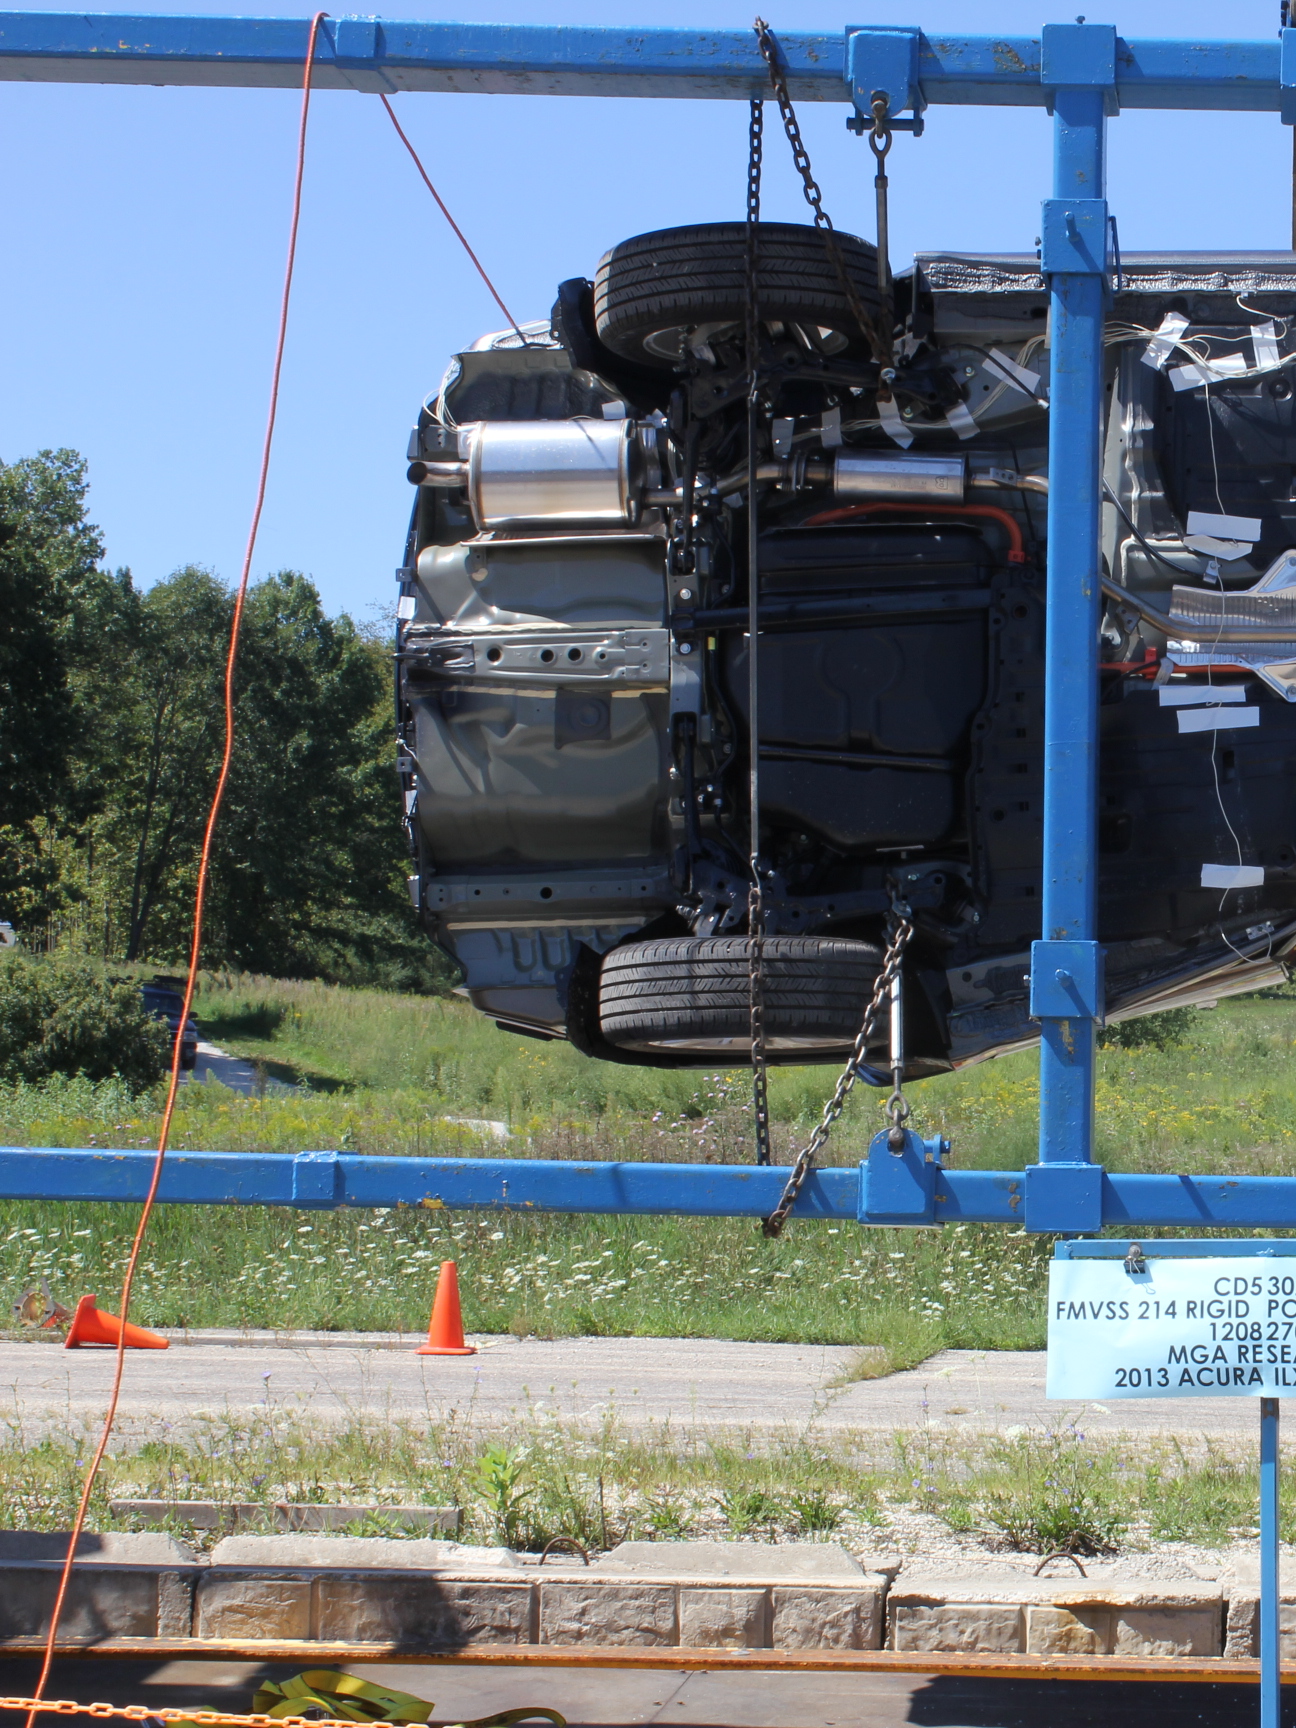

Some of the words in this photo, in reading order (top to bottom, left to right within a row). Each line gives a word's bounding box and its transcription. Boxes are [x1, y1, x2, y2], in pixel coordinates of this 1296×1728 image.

[1056, 1301, 1130, 1320] FMVSS
[1138, 1301, 1177, 1320] 214
[1186, 1300, 1250, 1319] RIGID
[1168, 1345, 1228, 1364] MGA
[1115, 1368, 1170, 1388] 2013
[1178, 1367, 1263, 1388] ACURA
